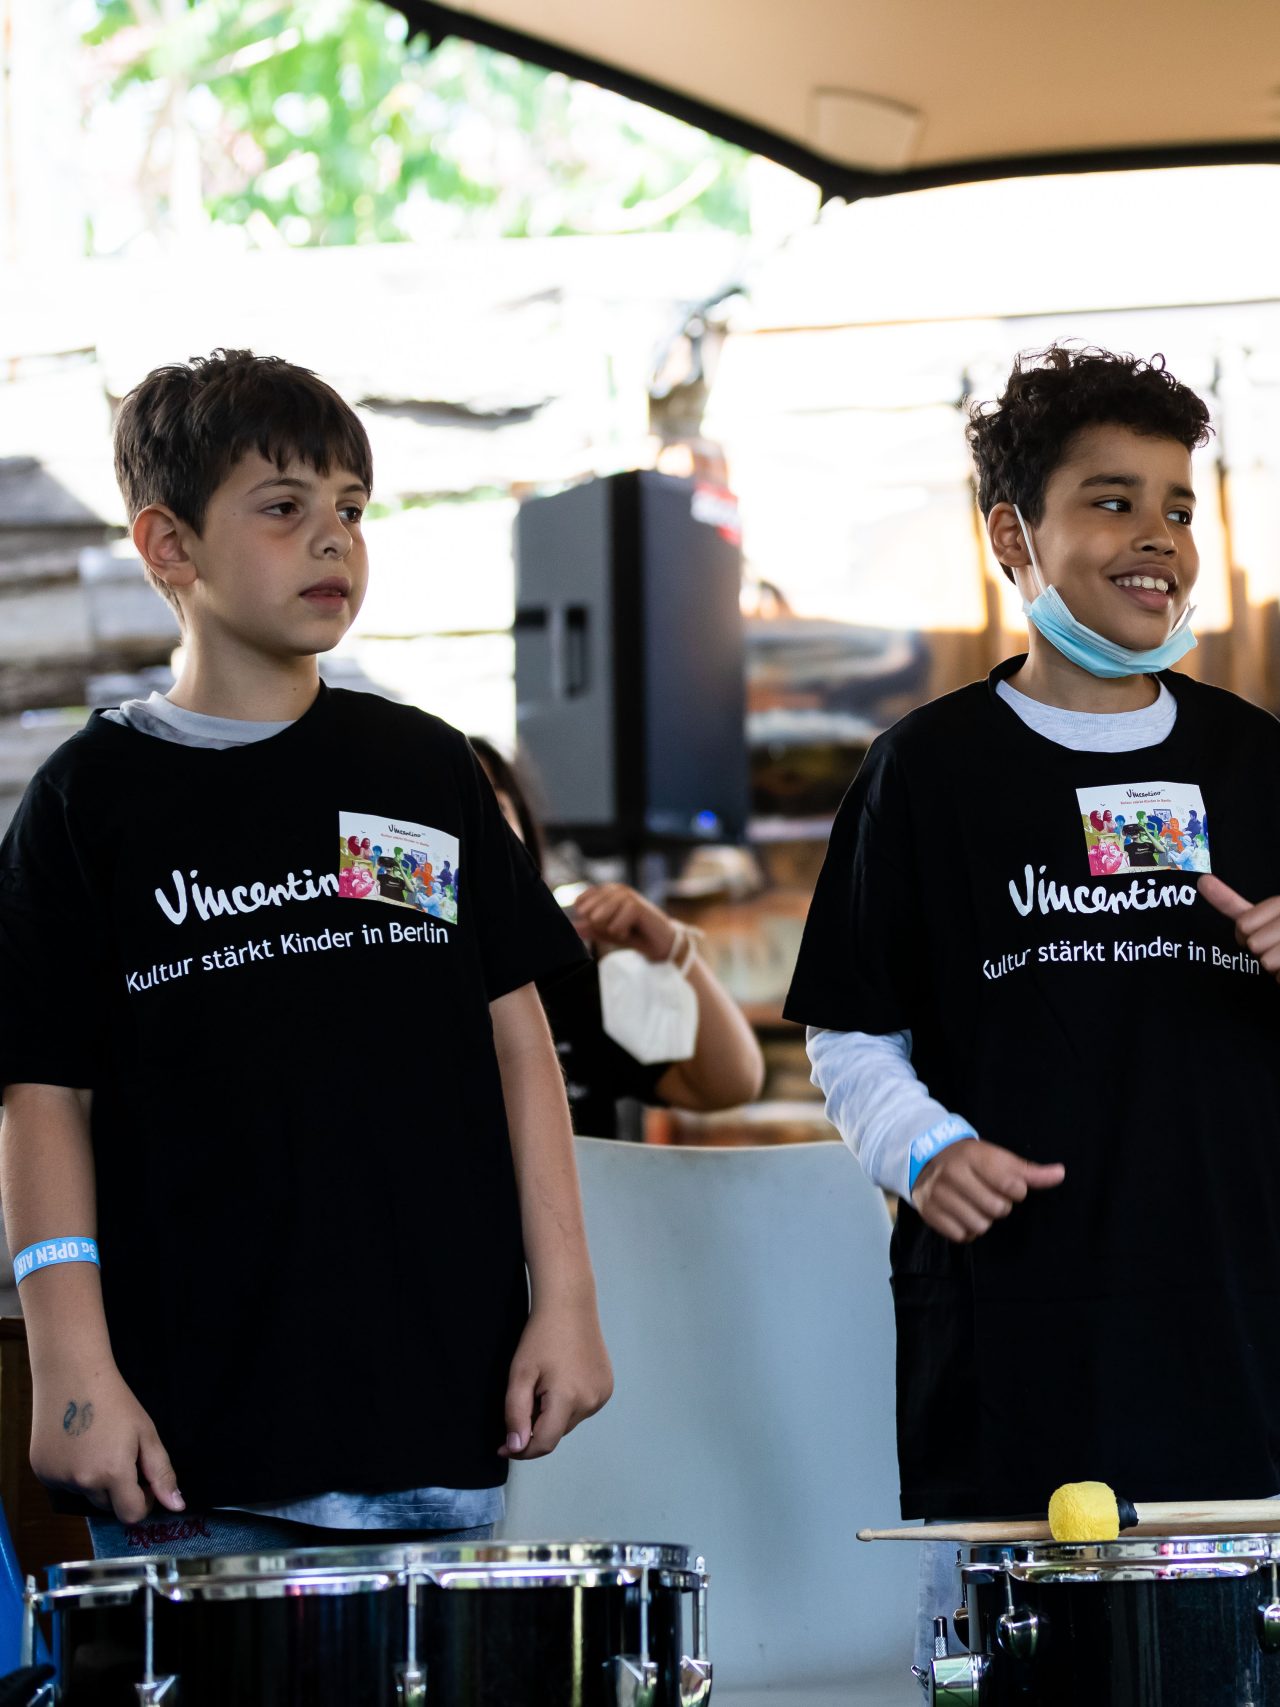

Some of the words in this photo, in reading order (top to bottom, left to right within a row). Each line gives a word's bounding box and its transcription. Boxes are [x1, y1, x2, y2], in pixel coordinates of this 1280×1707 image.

[154, 869, 339, 926] Vincentin
[1008, 863, 1197, 917] Vincentino
[125, 957, 194, 994] Kultur
[201, 939, 275, 971] stärkt
[280, 928, 354, 955] Kinder
[361, 922, 384, 945] in
[390, 922, 450, 944] Berlin
[1037, 940, 1106, 963] stärkt
[1113, 935, 1183, 962] Kinder
[1187, 941, 1206, 963] in
[1211, 945, 1260, 975] Berlin
[16, 1251, 34, 1275] AIR
[35, 1242, 79, 1265] OPEN
